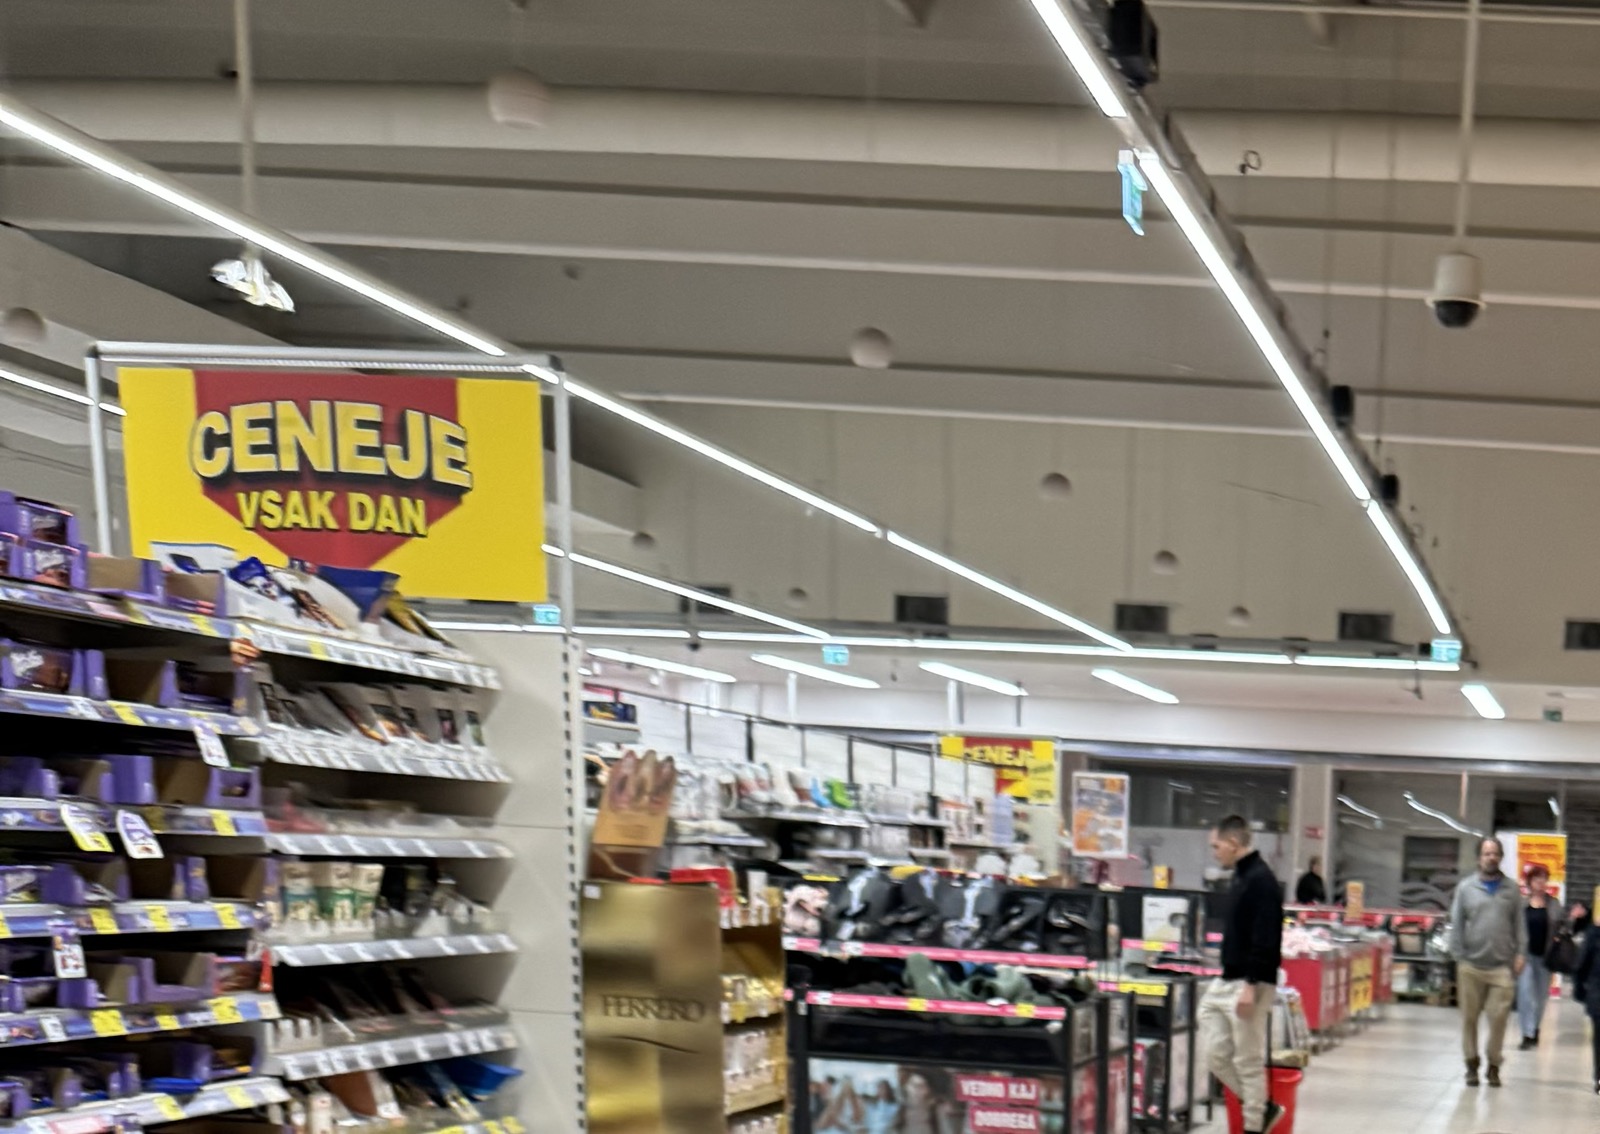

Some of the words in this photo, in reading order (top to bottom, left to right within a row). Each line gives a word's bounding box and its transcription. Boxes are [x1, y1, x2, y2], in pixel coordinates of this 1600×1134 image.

[190, 400, 474, 491] CENEJE
[236, 490, 340, 531] VSAK
[347, 491, 428, 538] DAN
[601, 994, 706, 1023] FERRERO
